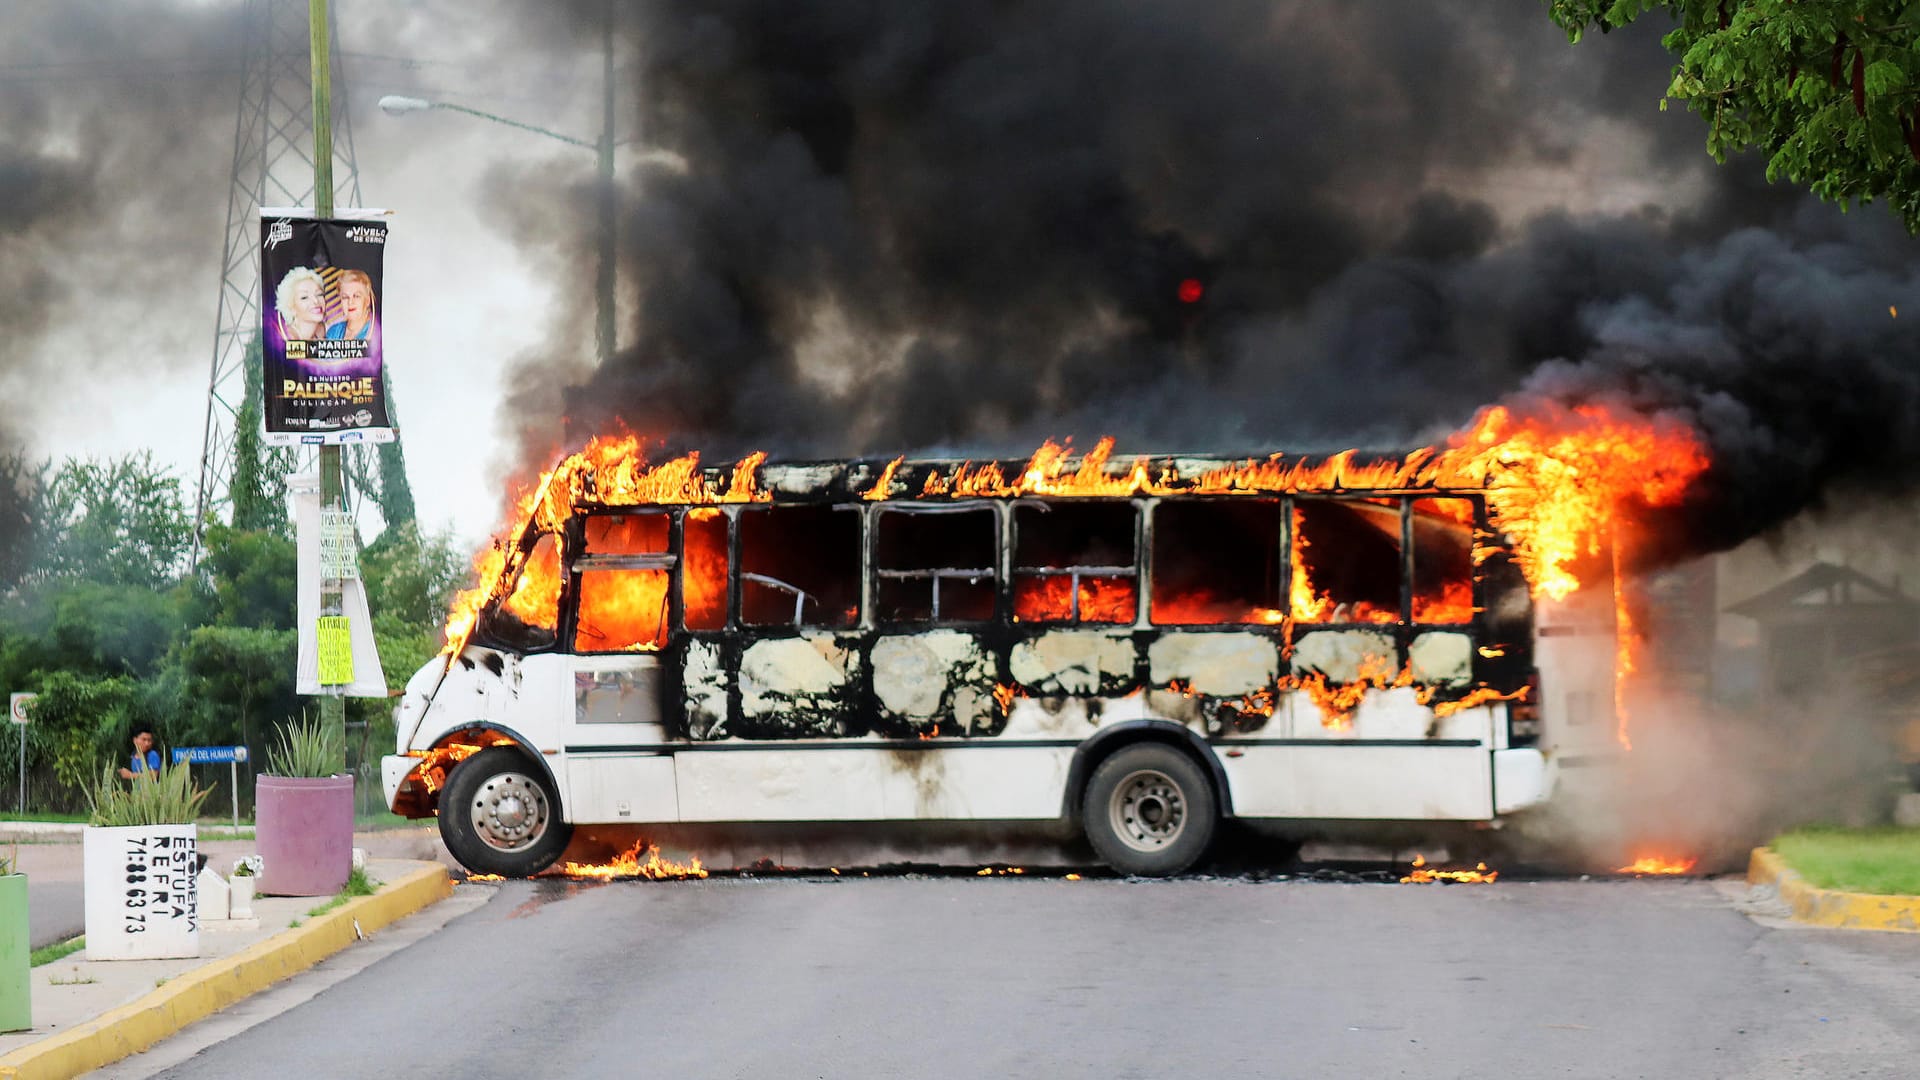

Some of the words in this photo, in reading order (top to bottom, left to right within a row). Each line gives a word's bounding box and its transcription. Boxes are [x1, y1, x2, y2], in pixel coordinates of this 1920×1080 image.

[318, 350, 363, 358] PAQUITA
[283, 377, 374, 399] PALENQUE
[151, 836, 170, 914] REFRI
[171, 837, 187, 919] ESTUFA
